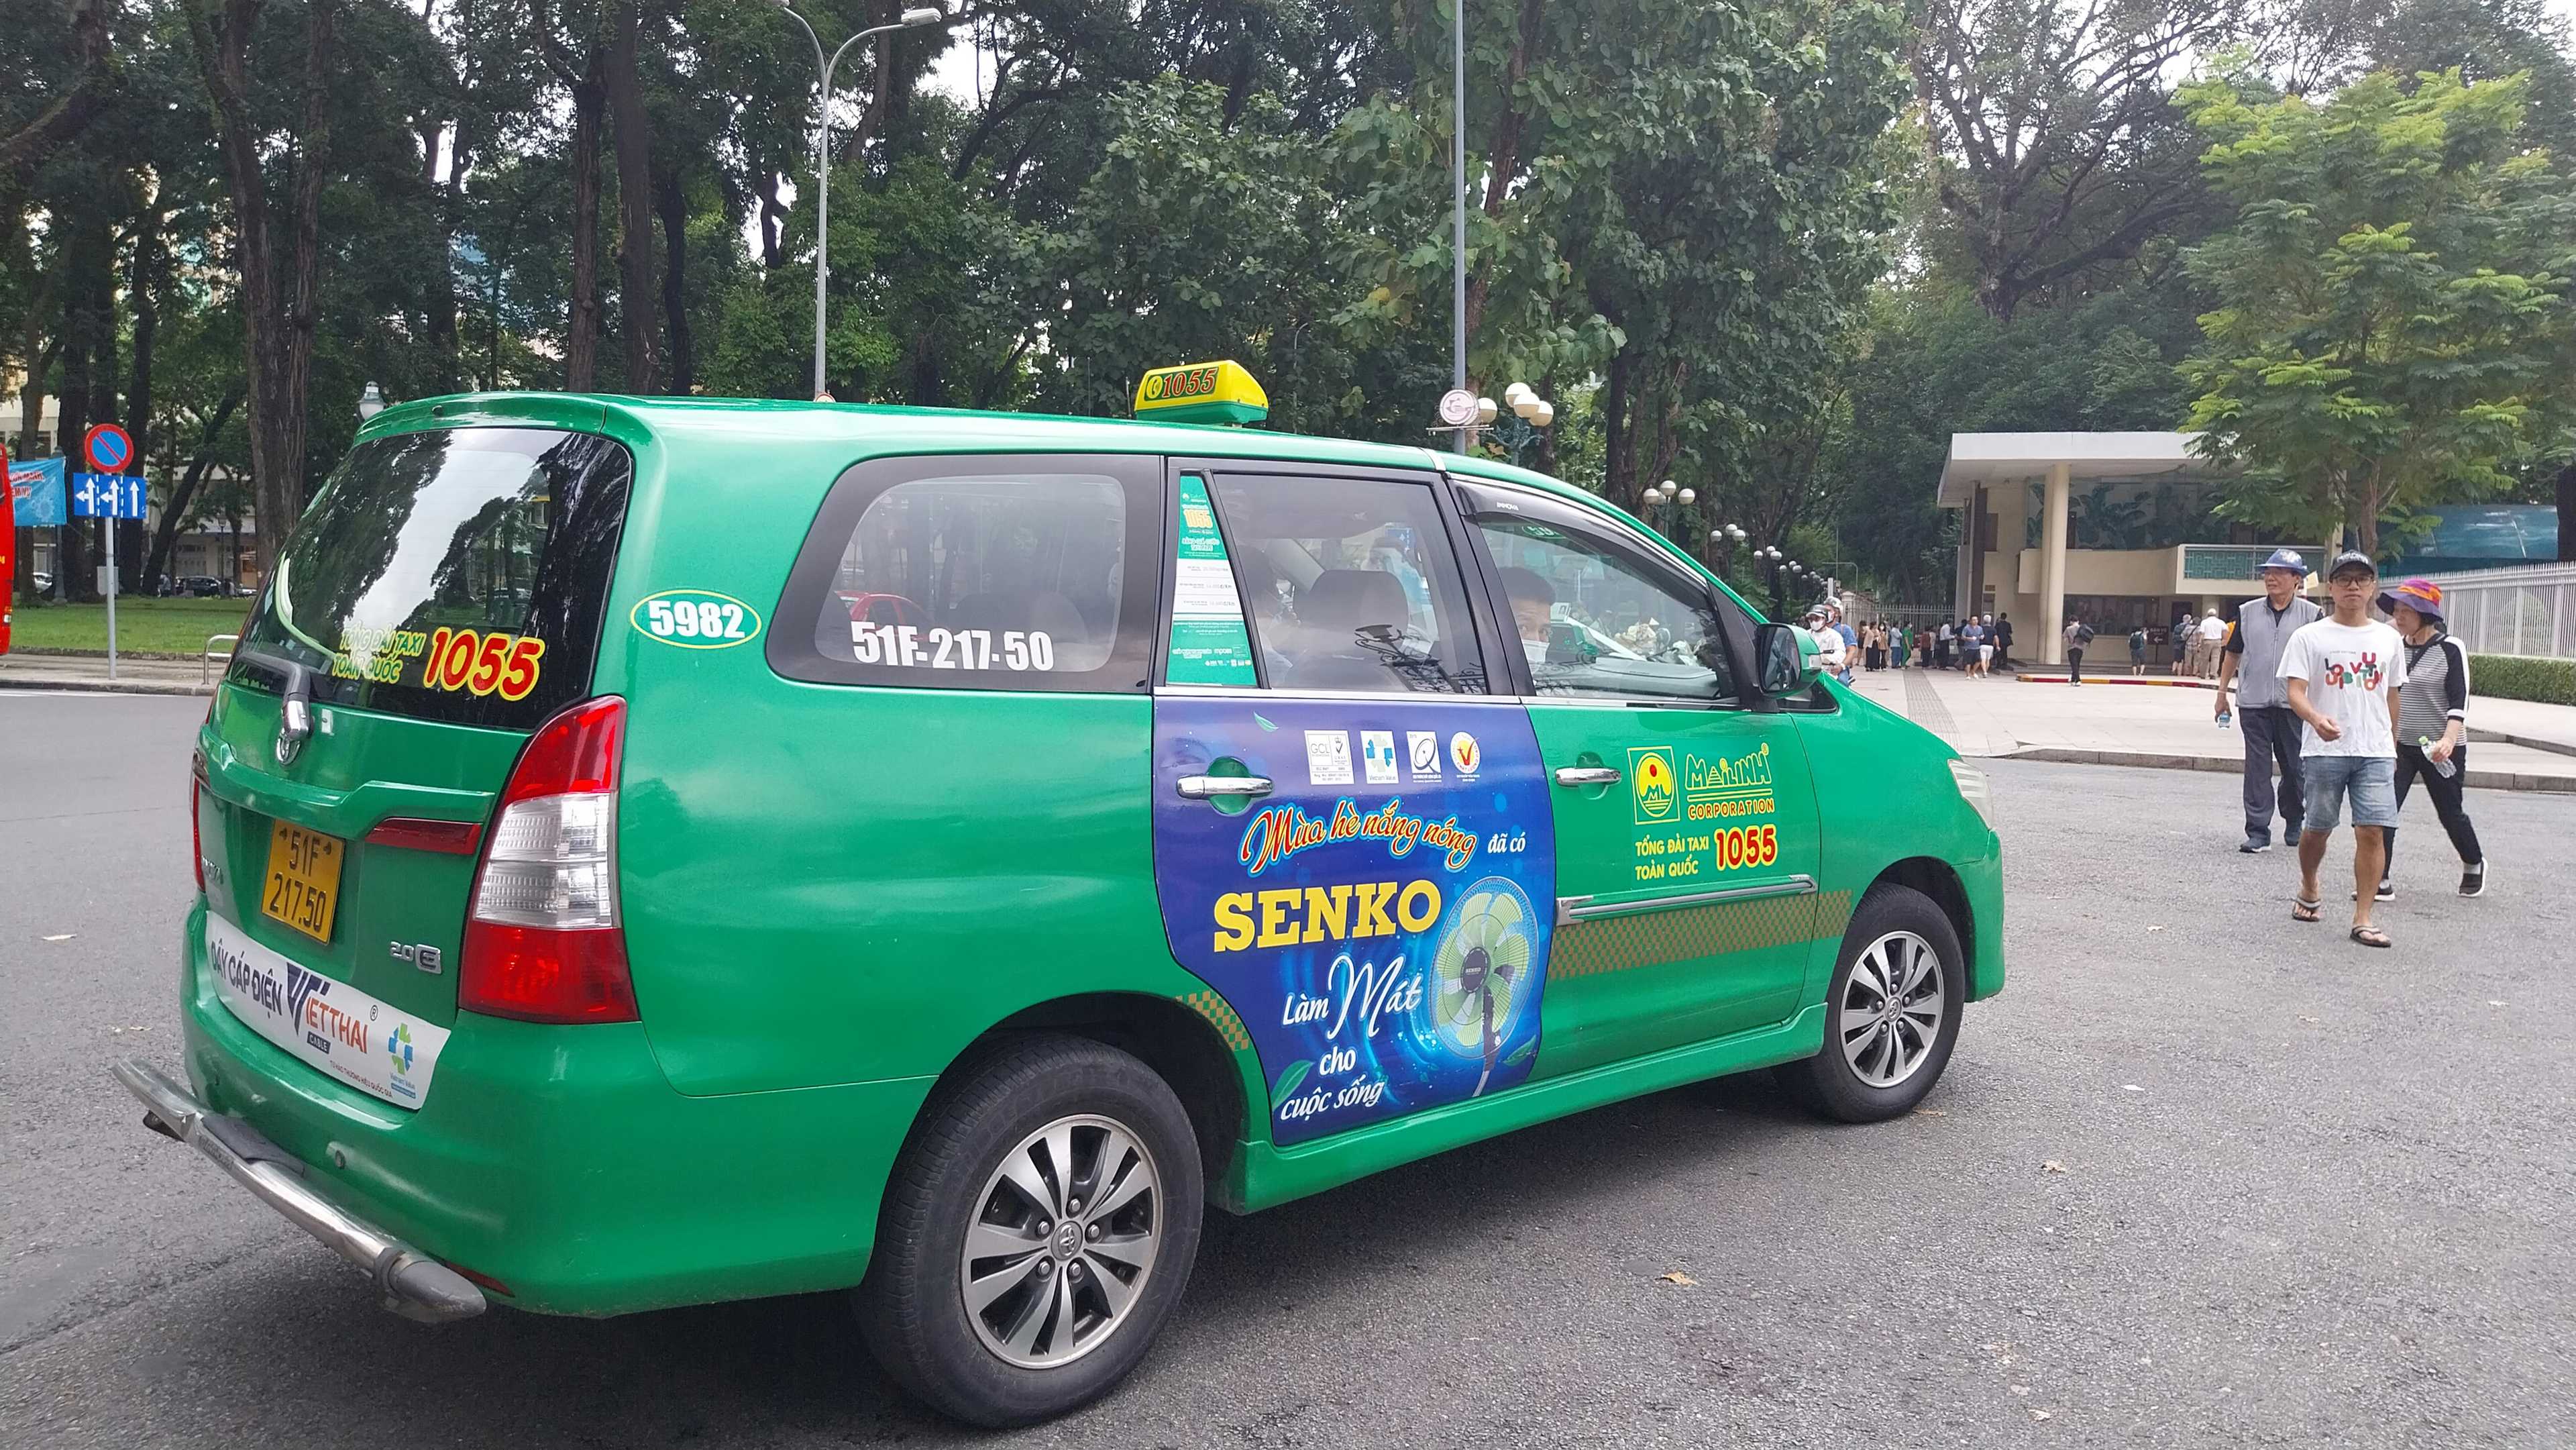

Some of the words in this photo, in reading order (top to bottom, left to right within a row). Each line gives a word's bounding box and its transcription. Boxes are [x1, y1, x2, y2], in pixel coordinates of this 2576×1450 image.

[1162, 367, 1218, 398] 1055
[1183, 509, 1214, 529] 1055
[1497, 502, 1519, 511] INNOVA
[648, 600, 745, 638] 5982
[392, 629, 426, 657] TAXI
[333, 650, 364, 680] TOÀN
[368, 650, 403, 684] QUỐC
[423, 626, 545, 701] 1055
[1688, 798, 1774, 821] CORPORATION
[289, 831, 321, 877] 51F
[1241, 807, 1326, 873] Mùa
[1330, 798, 1361, 840] hè
[1362, 798, 1422, 854] nắng
[1422, 817, 1477, 870] nóng
[1488, 833, 1507, 853] đã
[1509, 832, 1526, 853] có
[1635, 834, 1664, 856] TỔNG
[1667, 833, 1685, 853] ĐÀI
[1687, 836, 1709, 851] TAXI
[1714, 824, 1777, 871] 1055
[1635, 859, 1665, 880] TOÀN
[1668, 853, 1699, 877] QUỐC
[269, 872, 327, 933] 217.50
[1214, 880, 1442, 952] SENKO
[211, 938, 229, 980] DÂY
[228, 950, 250, 994] CÁP
[252, 968, 282, 1019] ĐIỆN
[1283, 993, 1330, 1025] Làm
[1327, 955, 1421, 1039] Mát
[1320, 1045, 1356, 1076] cho
[1280, 1086, 1332, 1121] cuộc
[1333, 1074, 1385, 1107] sống
